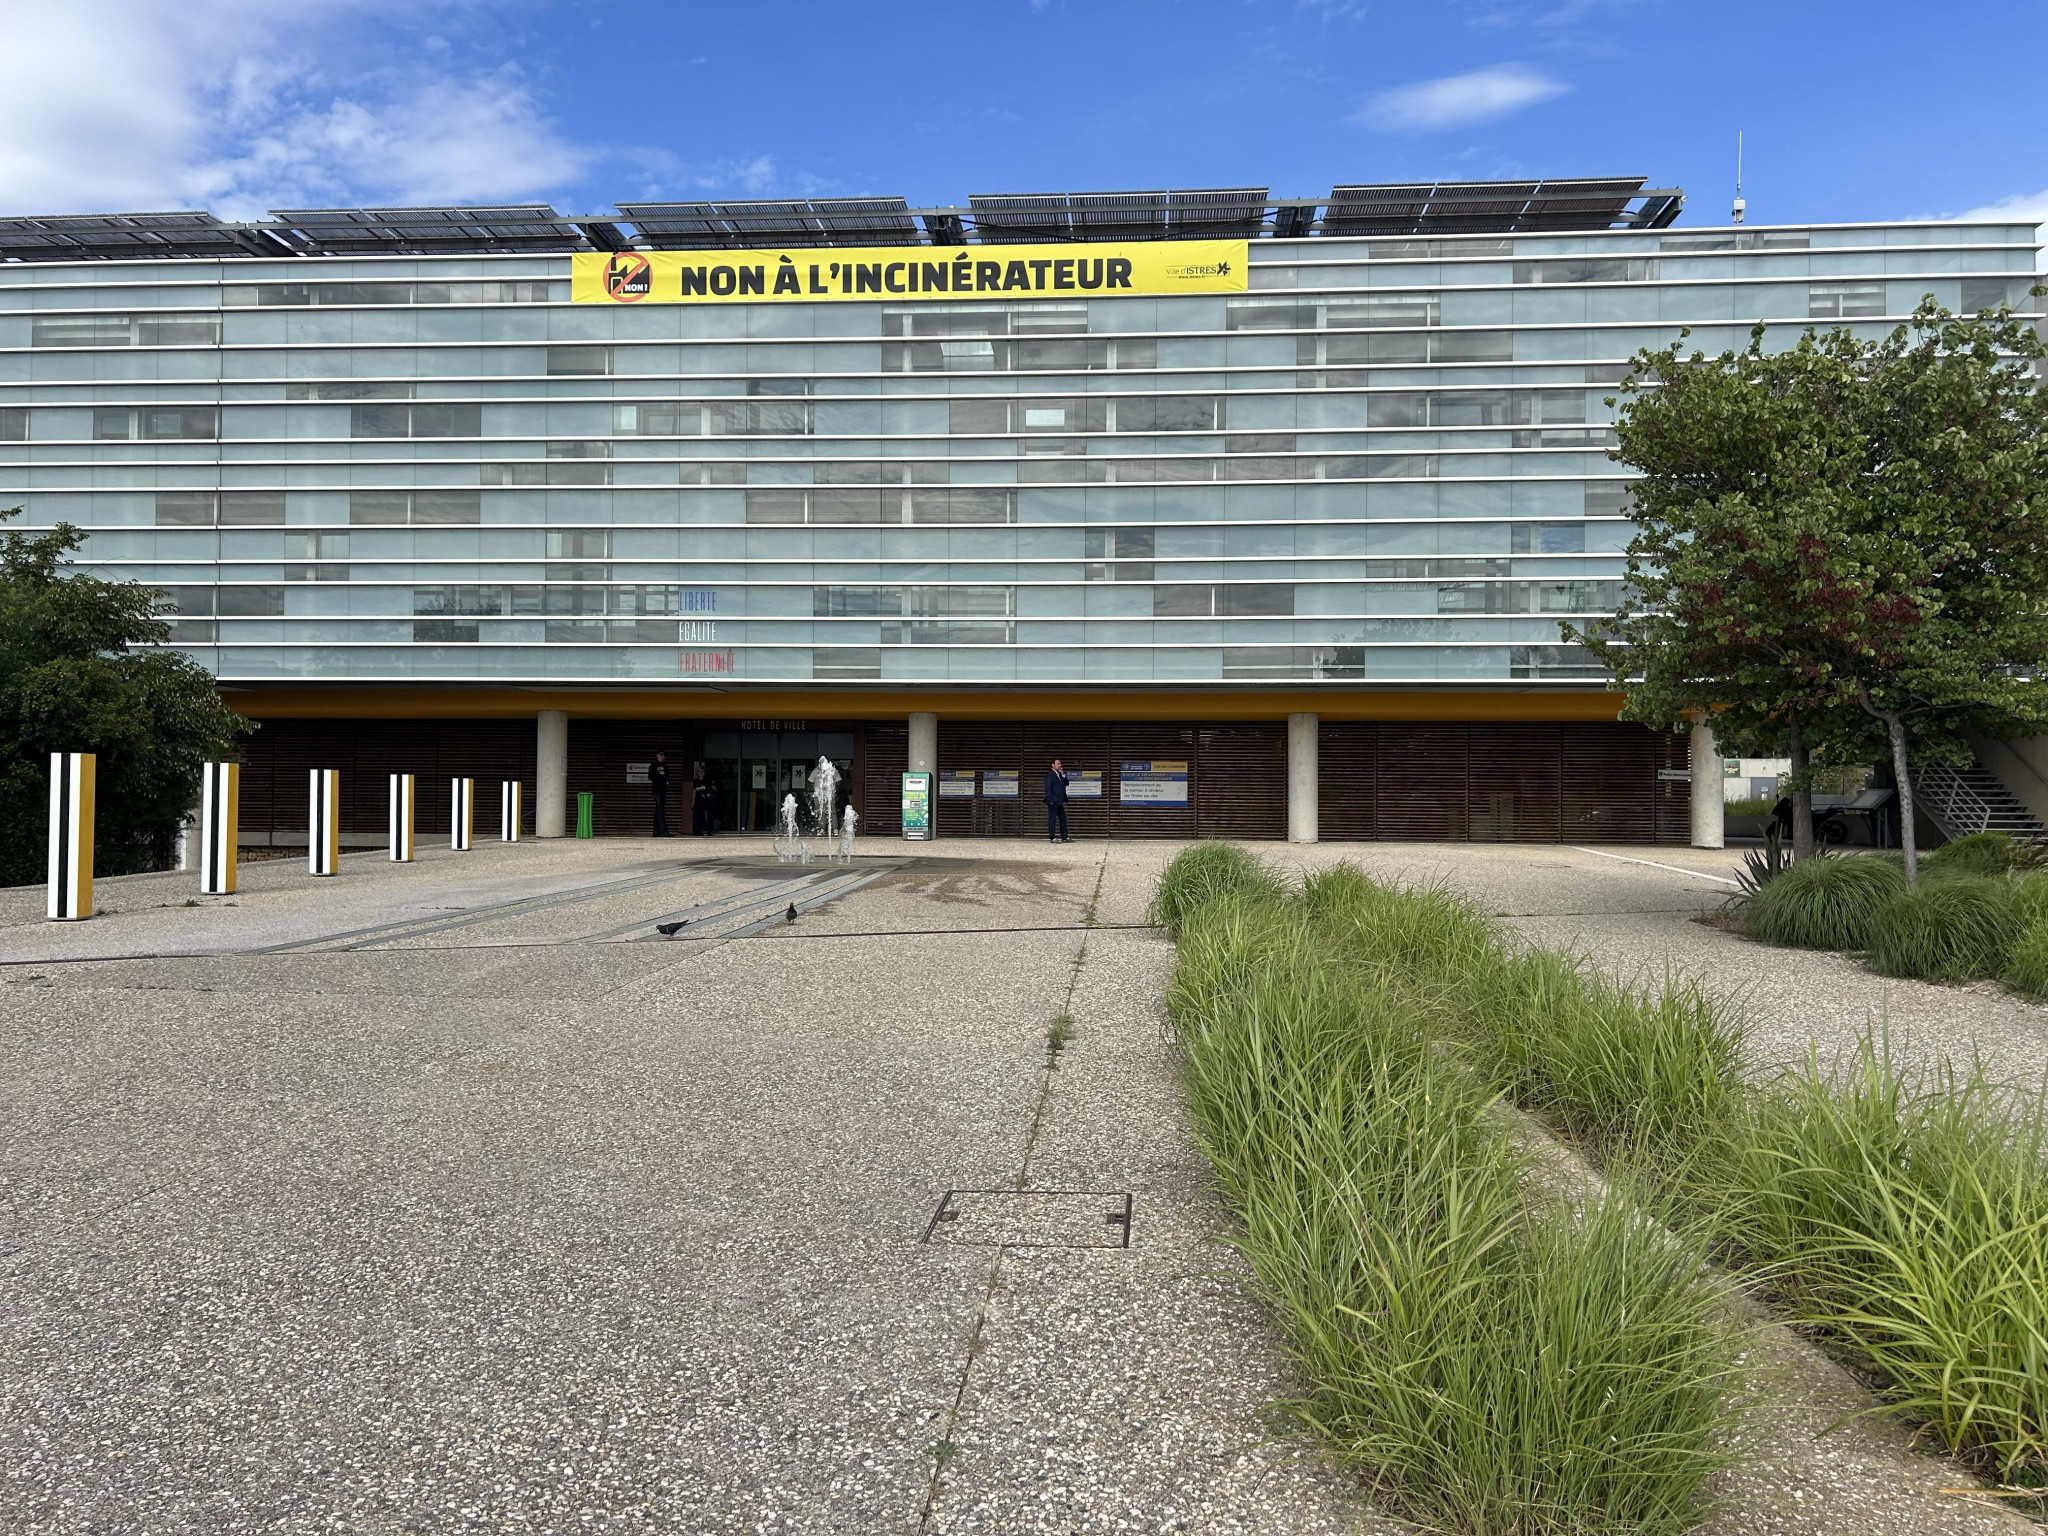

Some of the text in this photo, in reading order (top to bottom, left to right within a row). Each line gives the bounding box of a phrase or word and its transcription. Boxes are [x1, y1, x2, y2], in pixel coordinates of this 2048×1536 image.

[681, 252, 1133, 296] NON À L'INCINÉRATEUR
[679, 592, 717, 611] LIBERTE
[679, 622, 717, 641] EGALITE
[679, 652, 736, 672] FRATERNITE
[770, 720, 780, 730] DE
[783, 720, 806, 730] VILLE
